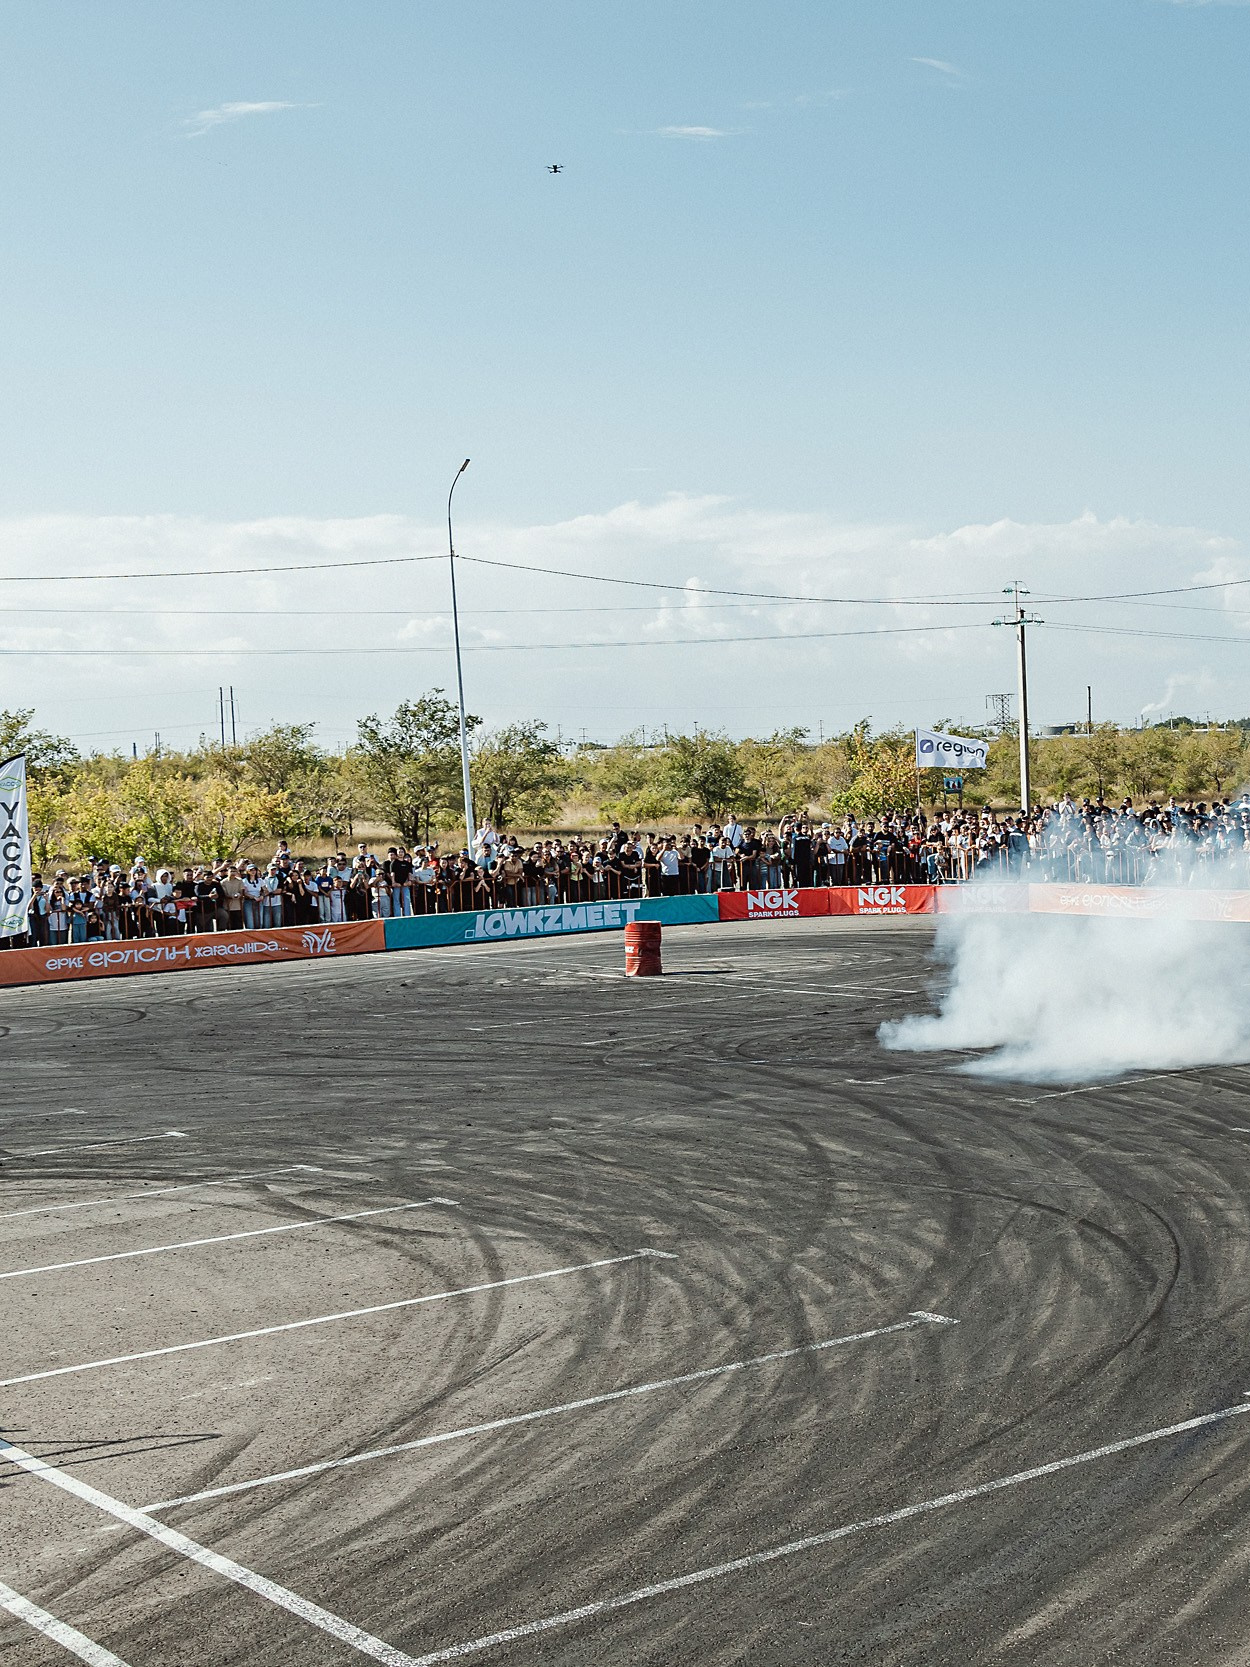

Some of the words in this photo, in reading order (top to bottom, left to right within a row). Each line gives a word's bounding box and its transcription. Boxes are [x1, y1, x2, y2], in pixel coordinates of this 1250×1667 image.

[936, 741, 985, 758] region
[0, 801, 24, 905] YACCO
[747, 890, 799, 910] NGK
[858, 886, 906, 906] NGK
[474, 902, 641, 938] LOWKZMEET
